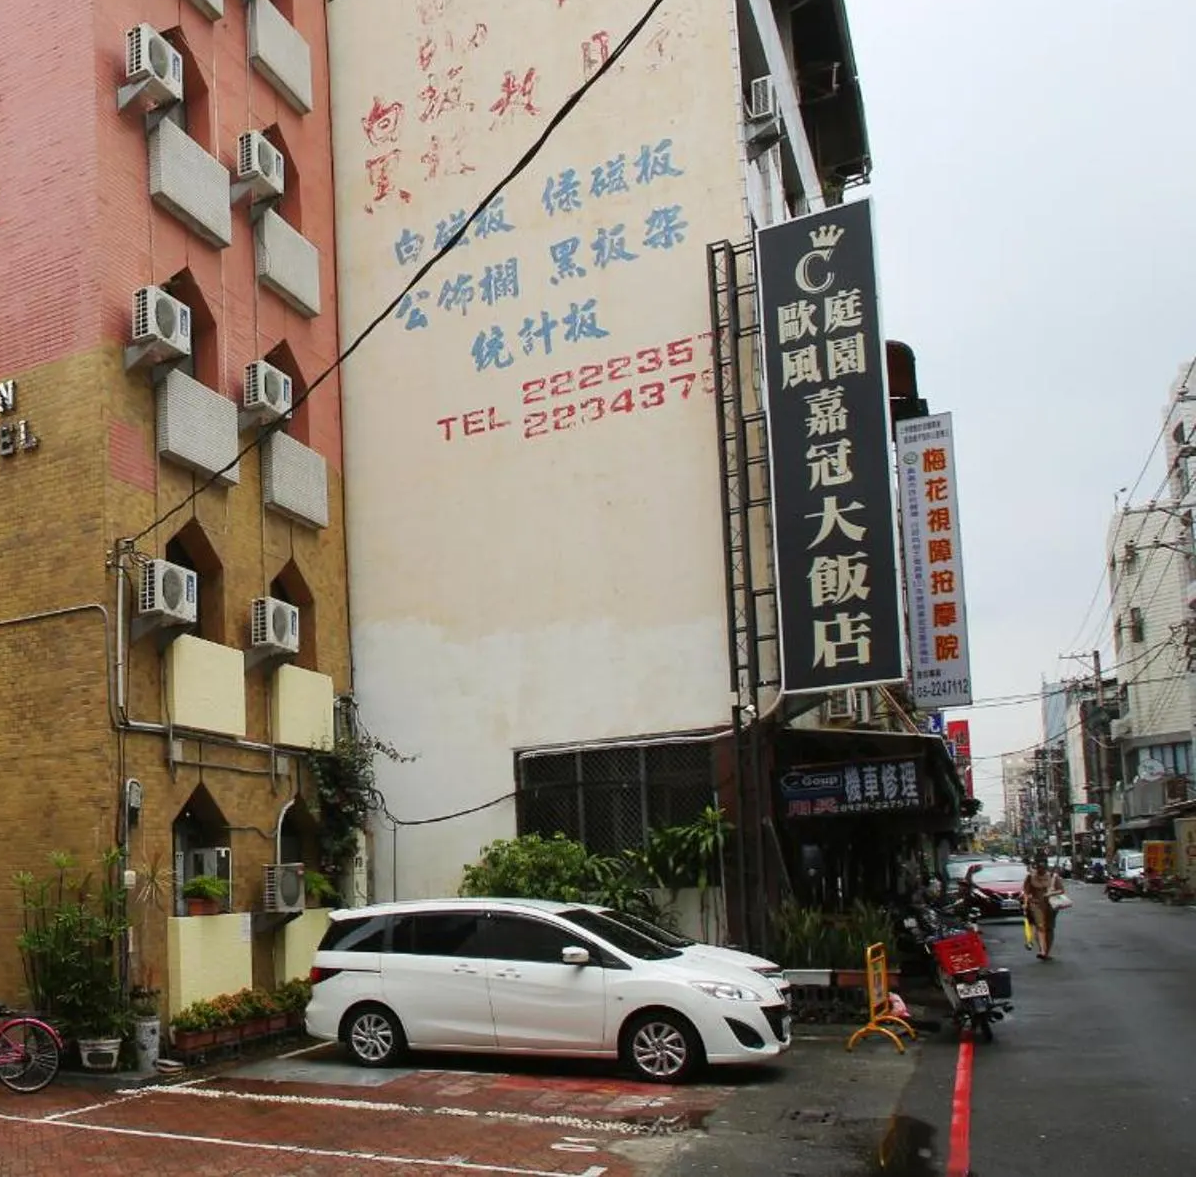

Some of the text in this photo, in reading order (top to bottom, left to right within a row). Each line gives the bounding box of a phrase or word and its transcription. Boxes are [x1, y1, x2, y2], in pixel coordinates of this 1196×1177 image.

[777, 288, 866, 391] 歐風 庭園
[437, 407, 511, 441] TEL
[804, 384, 873, 669] 嘉冠大飯店
